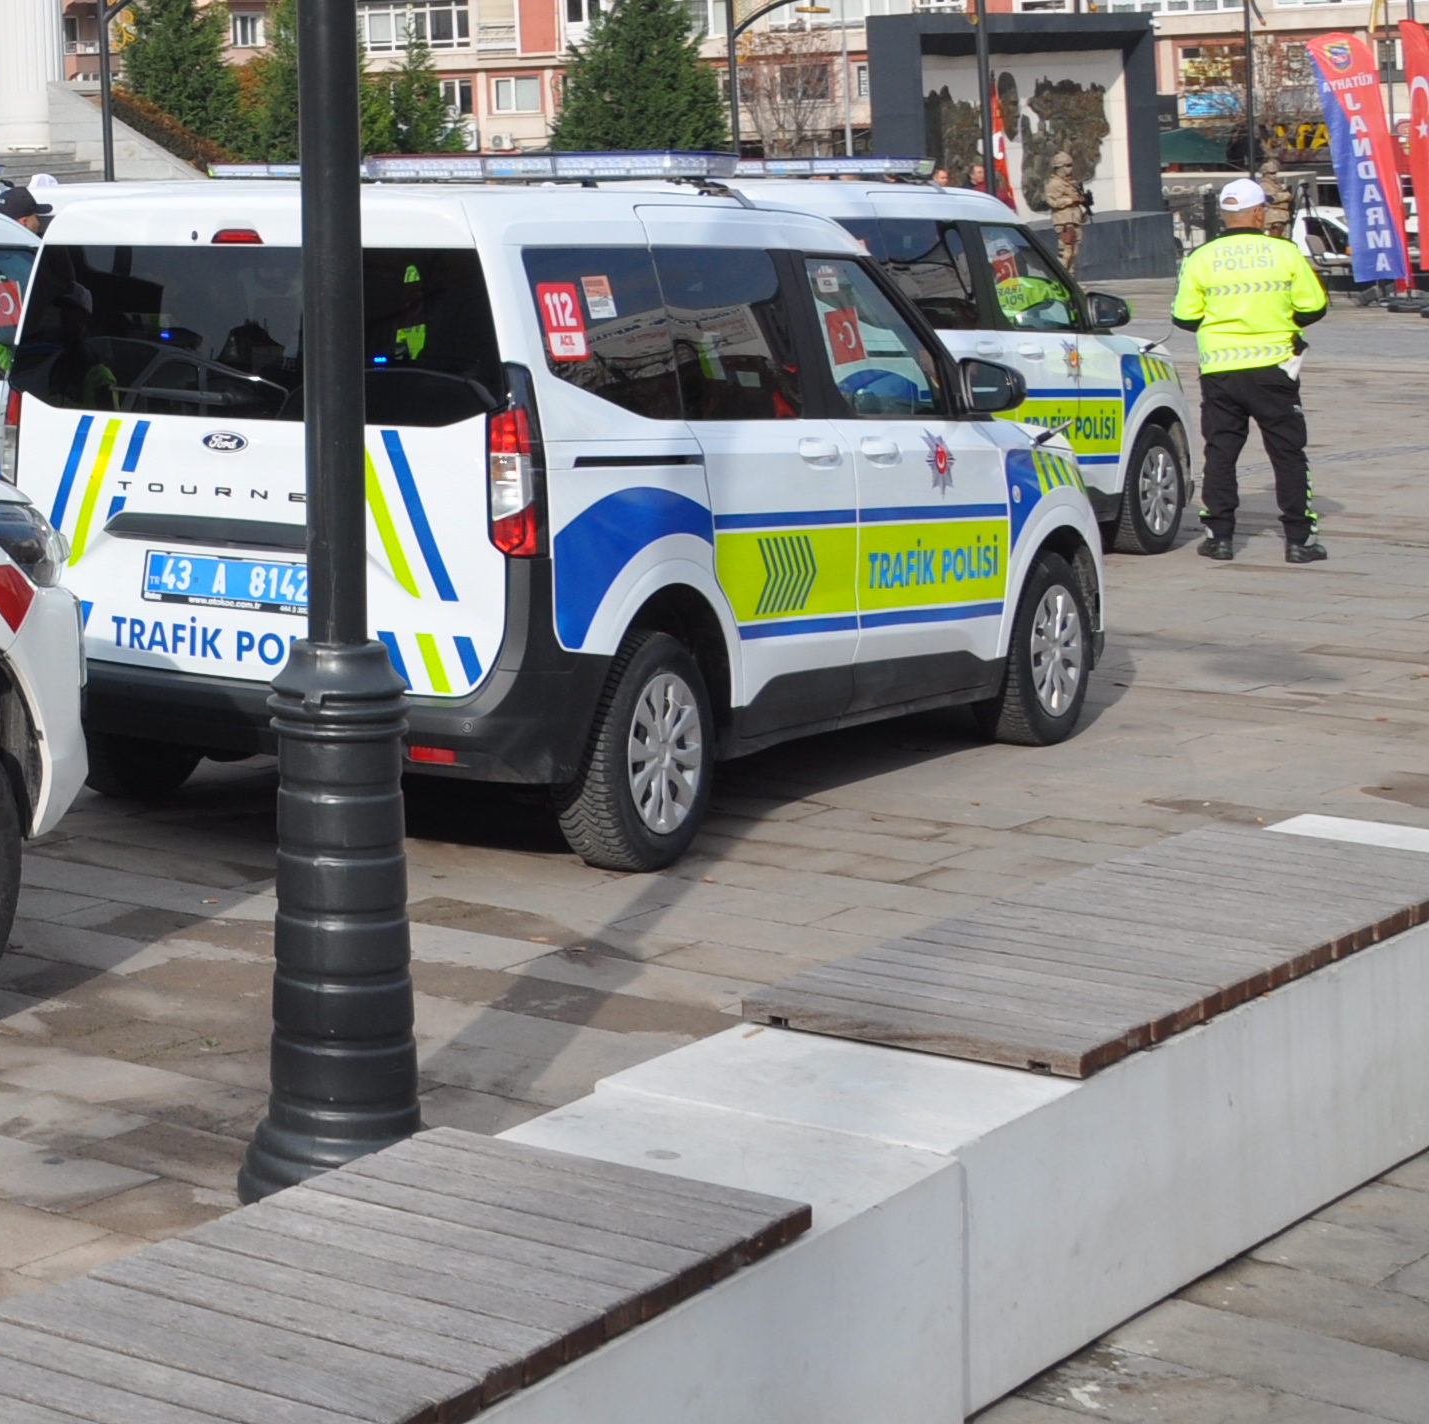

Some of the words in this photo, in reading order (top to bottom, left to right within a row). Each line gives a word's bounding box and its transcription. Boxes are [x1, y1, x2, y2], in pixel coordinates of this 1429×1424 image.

[1212, 255, 1275, 272] POLİSİ
[543, 291, 578, 328] 112
[1075, 408, 1116, 441] POLİSİ
[117, 480, 308, 504] TOURNE
[161, 557, 193, 592] 43
[211, 562, 227, 595] A
[867, 537, 936, 590] TRAFİK
[941, 533, 999, 584] POLİSİ
[111, 615, 223, 660] TRAFİK
